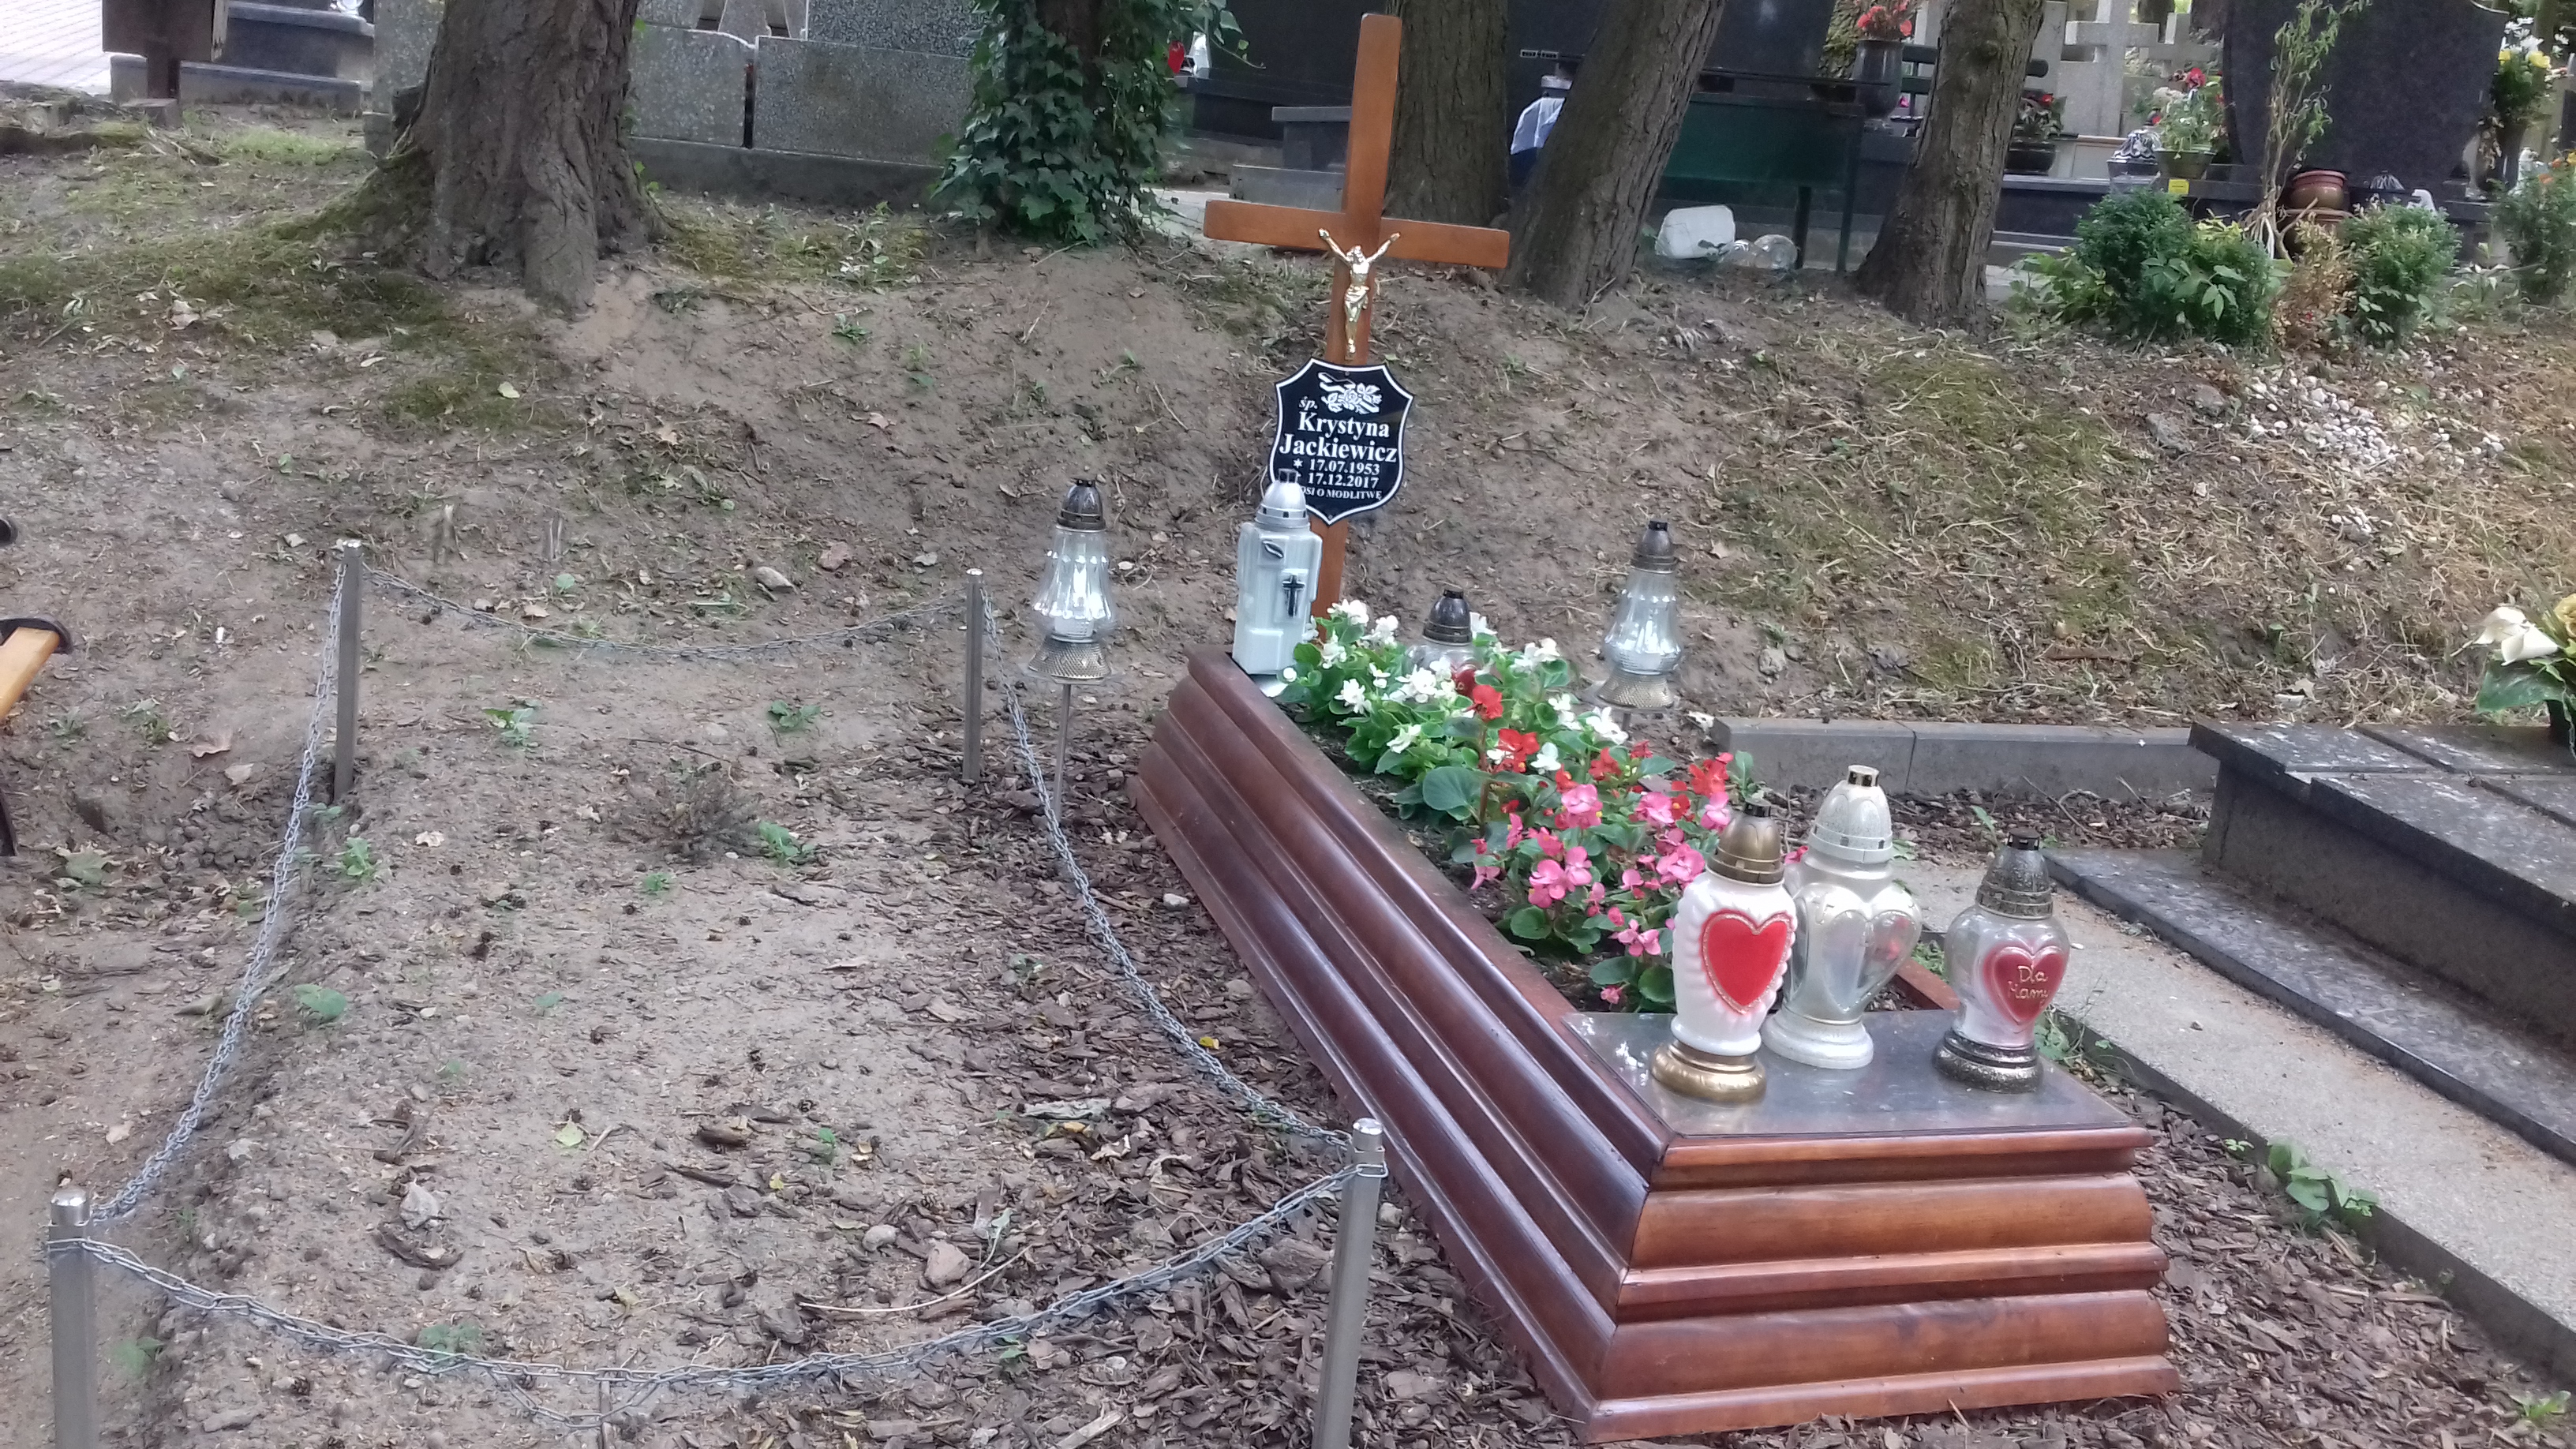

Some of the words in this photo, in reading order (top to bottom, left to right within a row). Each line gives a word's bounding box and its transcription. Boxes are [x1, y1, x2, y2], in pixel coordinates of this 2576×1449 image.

[1297, 410, 1390, 440] Krystyna
[1279, 433, 1398, 462] Jackiewicz
[1309, 459, 1380, 475] 17.07.1953
[1308, 472, 1380, 489] 17.12.2017
[1301, 485, 1316, 496] OSI
[1316, 488, 1325, 497] O
[2017, 964, 2049, 984] Dla
